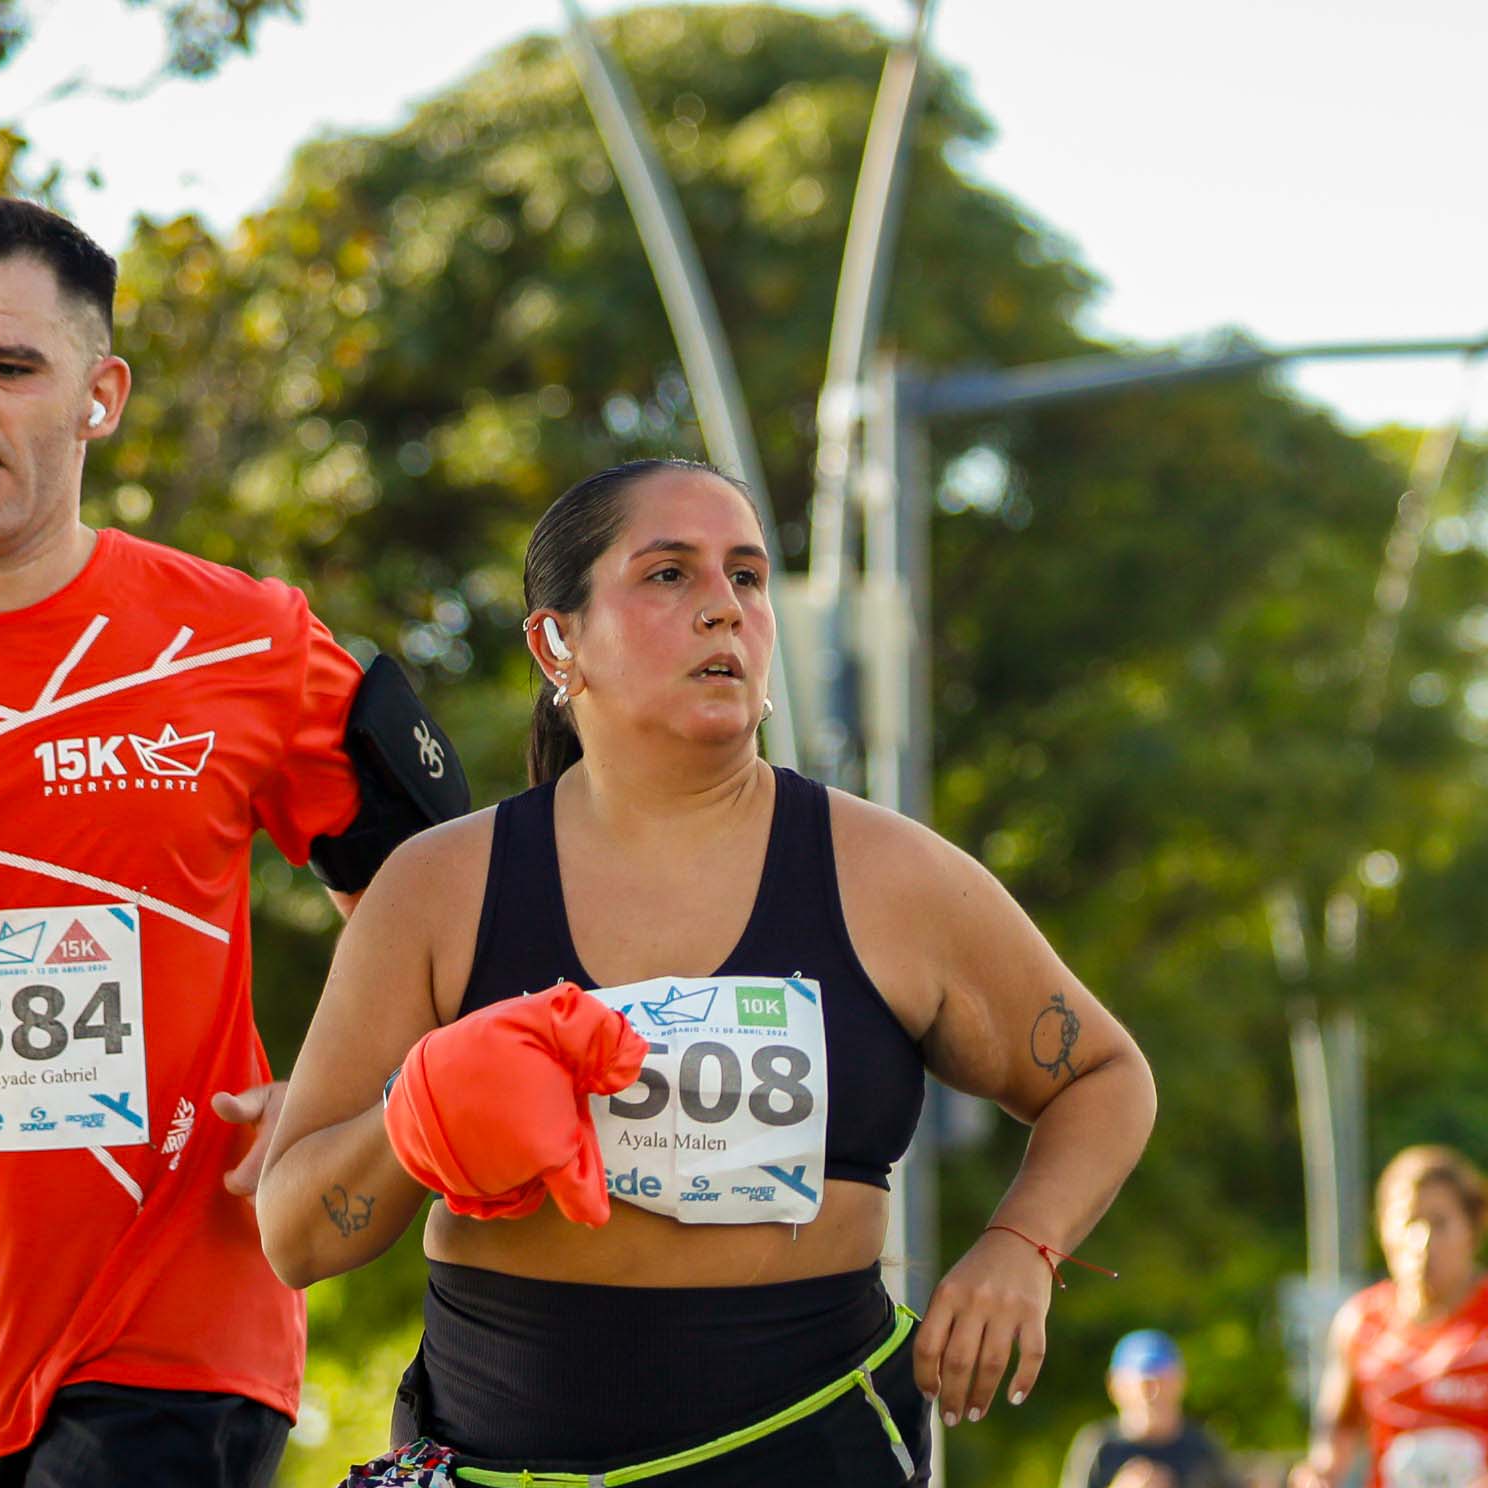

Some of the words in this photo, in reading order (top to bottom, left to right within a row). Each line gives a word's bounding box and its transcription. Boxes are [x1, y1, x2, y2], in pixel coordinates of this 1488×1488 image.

[34, 735, 128, 782] 15K
[44, 778, 127, 797] PUERTO
[135, 777, 198, 793] NORTE
[59, 938, 96, 959] 15K
[741, 997, 781, 1016] 10K
[41, 1067, 98, 1085] Gabriel
[618, 1130, 668, 1150] Ayala
[673, 1133, 727, 1151] Malen
